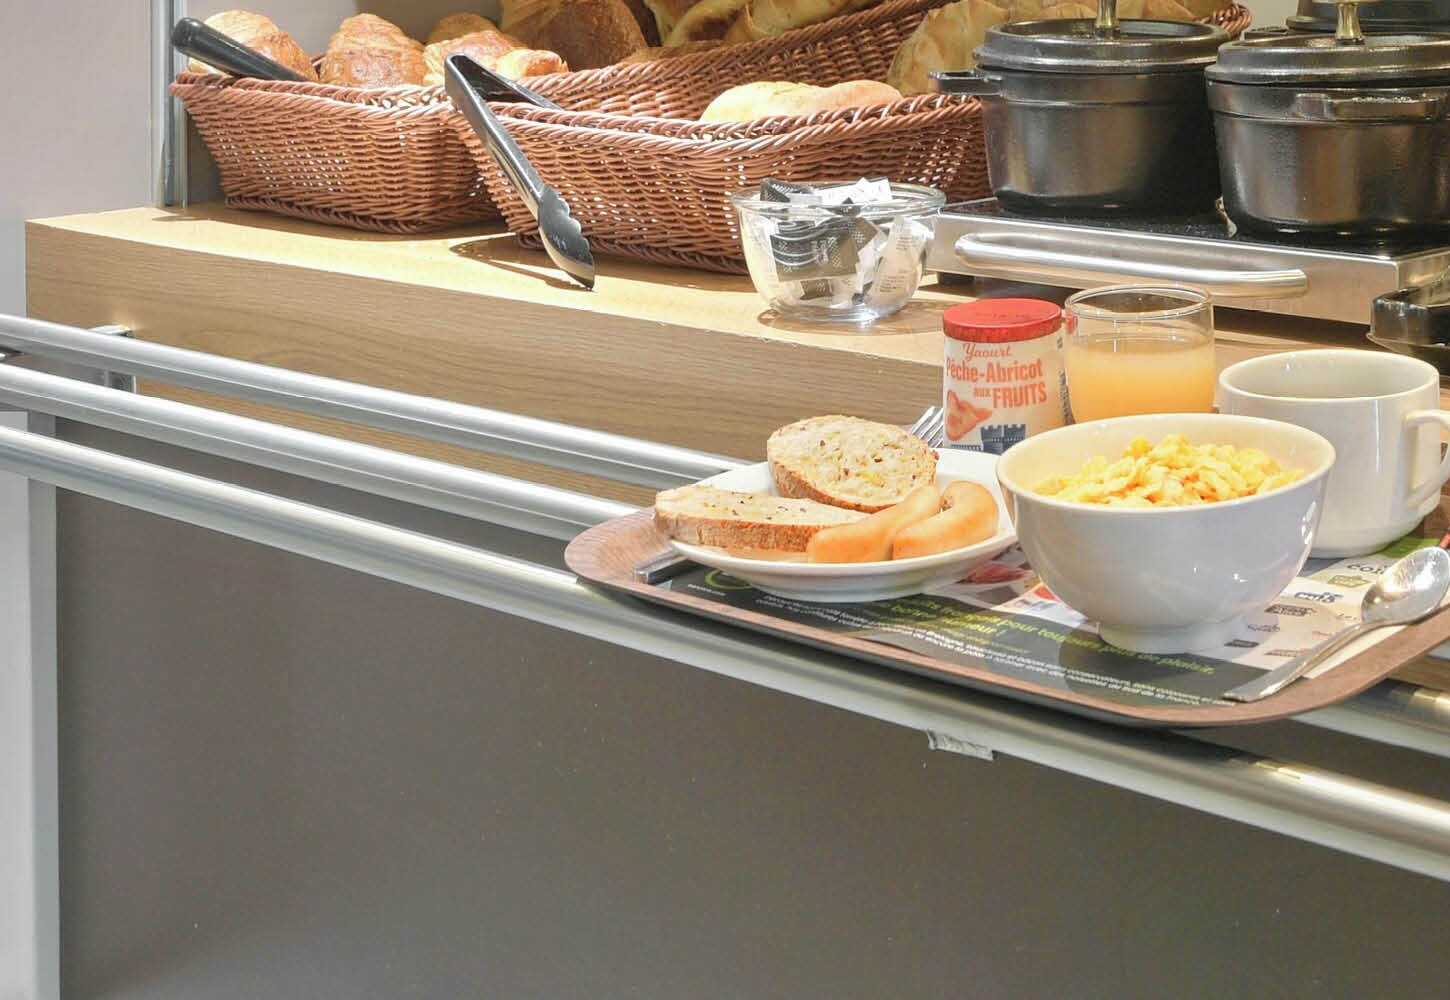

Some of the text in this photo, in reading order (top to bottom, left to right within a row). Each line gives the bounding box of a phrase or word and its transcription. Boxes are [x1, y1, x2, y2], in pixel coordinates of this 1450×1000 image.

[962, 343, 1012, 362] Yaourt
[946, 358, 1044, 384] Pêche-Abricot
[973, 381, 1048, 409] aux FRUITS
